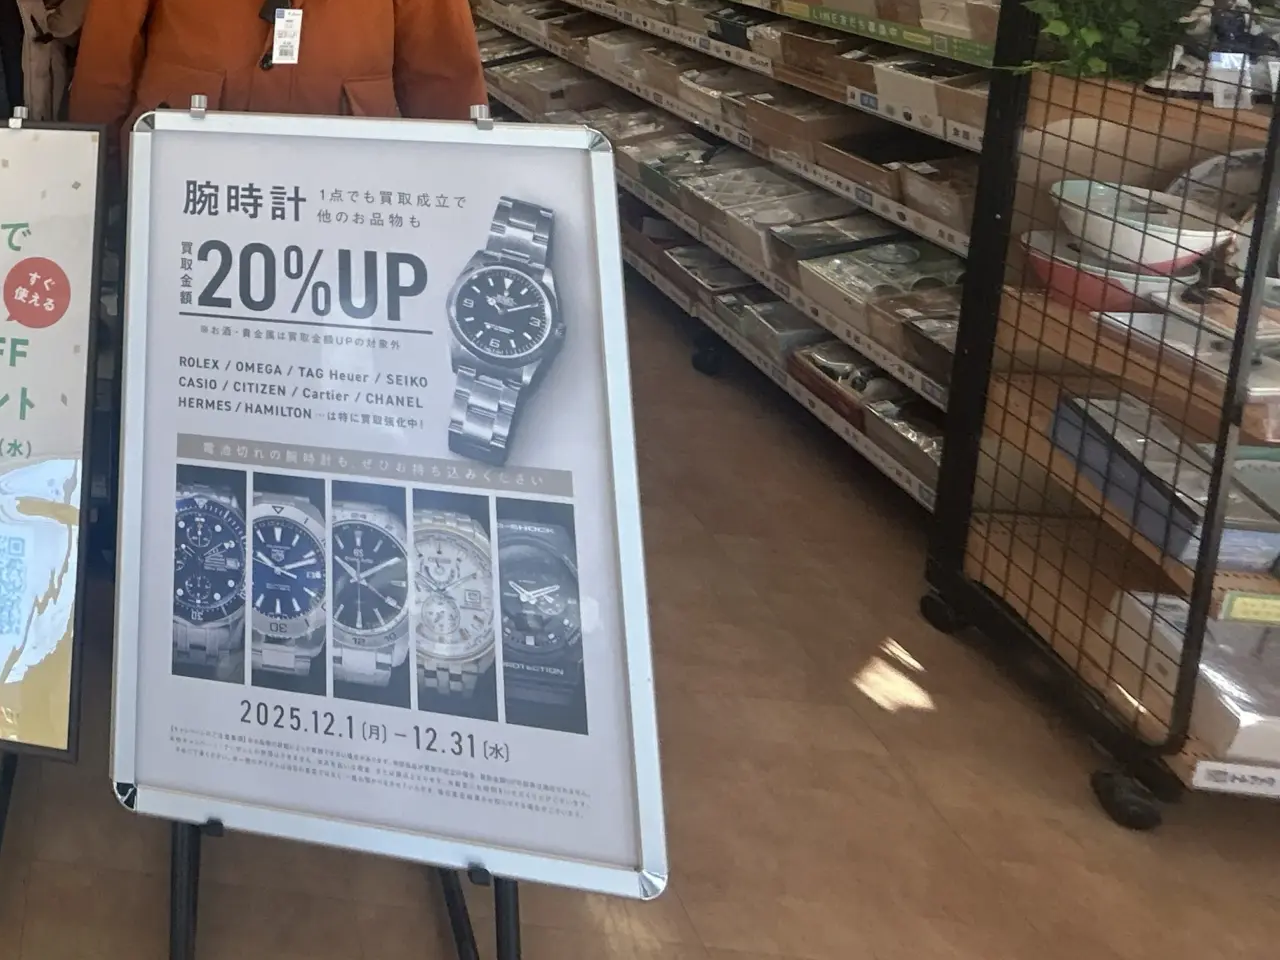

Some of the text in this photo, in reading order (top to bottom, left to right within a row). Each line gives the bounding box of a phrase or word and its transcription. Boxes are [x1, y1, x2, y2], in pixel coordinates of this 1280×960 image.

[182, 180, 307, 222] 腕時計
[319, 188, 467, 209] 1点でも買取成立で
[317, 209, 422, 229] 他のお品物も
[28, 271, 56, 292] すぐ
[179, 240, 194, 306] 買取金額
[197, 239, 428, 322] 20%UP
[14, 285, 56, 313] 使える
[179, 356, 219, 371] ROLEX
[235, 361, 282, 376] OMEGA
[298, 365, 324, 380] TAG
[329, 370, 369, 384] Heuer
[386, 372, 428, 388] SEIKO
[178, 376, 218, 391] CASIO
[233, 381, 286, 397] CITIZEN
[302, 386, 350, 402] Cartier
[365, 393, 424, 409] CHANEL
[178, 397, 231, 412] HERMES
[245, 402, 312, 420] HAMILTON
